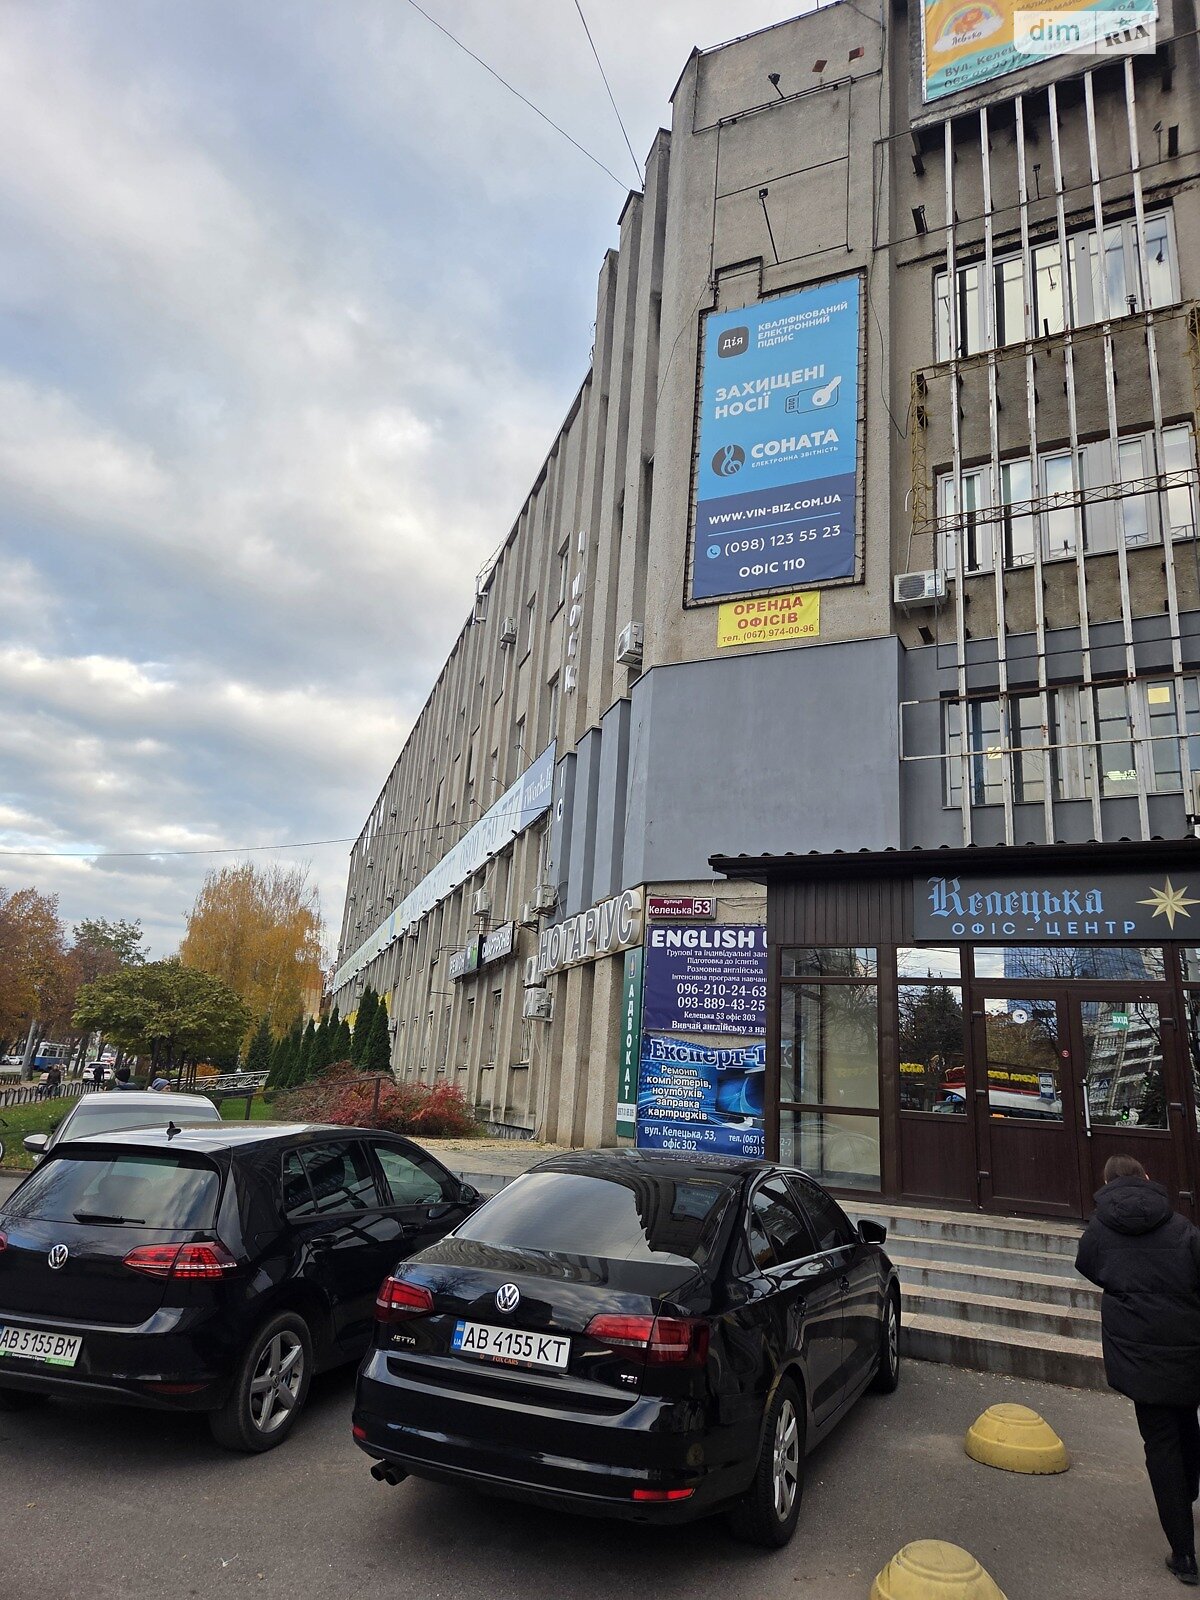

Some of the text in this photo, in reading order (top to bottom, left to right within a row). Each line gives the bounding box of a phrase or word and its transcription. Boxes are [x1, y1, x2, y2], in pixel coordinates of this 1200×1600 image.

[758, 301, 848, 331] КВАЛІФІКОВАНИЙ
[757, 315, 830, 340] ЕЛЕКТРОННИЙ
[722, 336, 743, 350] Дія
[757, 333, 794, 348] ПІДПИС
[715, 364, 825, 402] ЗАХИЩЕНІ
[715, 392, 771, 419] НОСІЇ
[751, 428, 839, 459] СОНАТА
[751, 446, 839, 468] ЕЛЕКТРОННА ЗВІТНІСТЬ
[708, 494, 841, 525] WWW.VIN-BIZ.COM.UA
[725, 524, 841, 557] (098) 123 55 23
[739, 557, 806, 578] ОФІС 110
[734, 596, 803, 615] ОРЕНДА
[737, 612, 798, 629] ОФІСІВ
[743, 629, 766, 641] (067)
[768, 624, 814, 637] 974-00-96
[927, 875, 1104, 924] Келецька
[649, 900, 711, 915] Келецька 53
[538, 889, 641, 973] НОТАРІУС
[651, 929, 755, 948] ENGLISH
[666, 949, 693, 957] Групові
[687, 957, 723, 965] Підготовка
[734, 958, 759, 966] іспитів
[723, 966, 764, 975] англійська
[708, 975, 740, 983] програма
[741, 975, 767, 983] навчан
[676, 982, 767, 997] 096-210-24-63
[677, 996, 766, 1011] 093-889-43-25
[684, 1011, 715, 1019] Келецька
[726, 1013, 741, 1022] офіс
[671, 1020, 701, 1030] Вивчай
[702, 1022, 747, 1034] англійську
[624, 984, 635, 1100] АДВОКАТ
[661, 1065, 698, 1076] Ремонт
[646, 1075, 712, 1089] комп'ютерів,
[652, 1086, 705, 1100] ноутбуків,
[656, 1097, 700, 1109] заправка
[648, 1108, 708, 1121] картриджів
[644, 1126, 717, 1141] вул. Келецька, 53,
[728, 1135, 742, 1143] тел.
[742, 1134, 760, 1145] (067)
[663, 1139, 697, 1151] офіс 302
[742, 1145, 760, 1155] (093)
[0, 1329, 19, 1349] AB
[20, 1332, 55, 1354] 5155
[54, 1337, 78, 1358] BM
[391, 1334, 416, 1346] JETTA
[464, 1327, 567, 1363] AB 4155 KT
[620, 1373, 638, 1384] TSI
